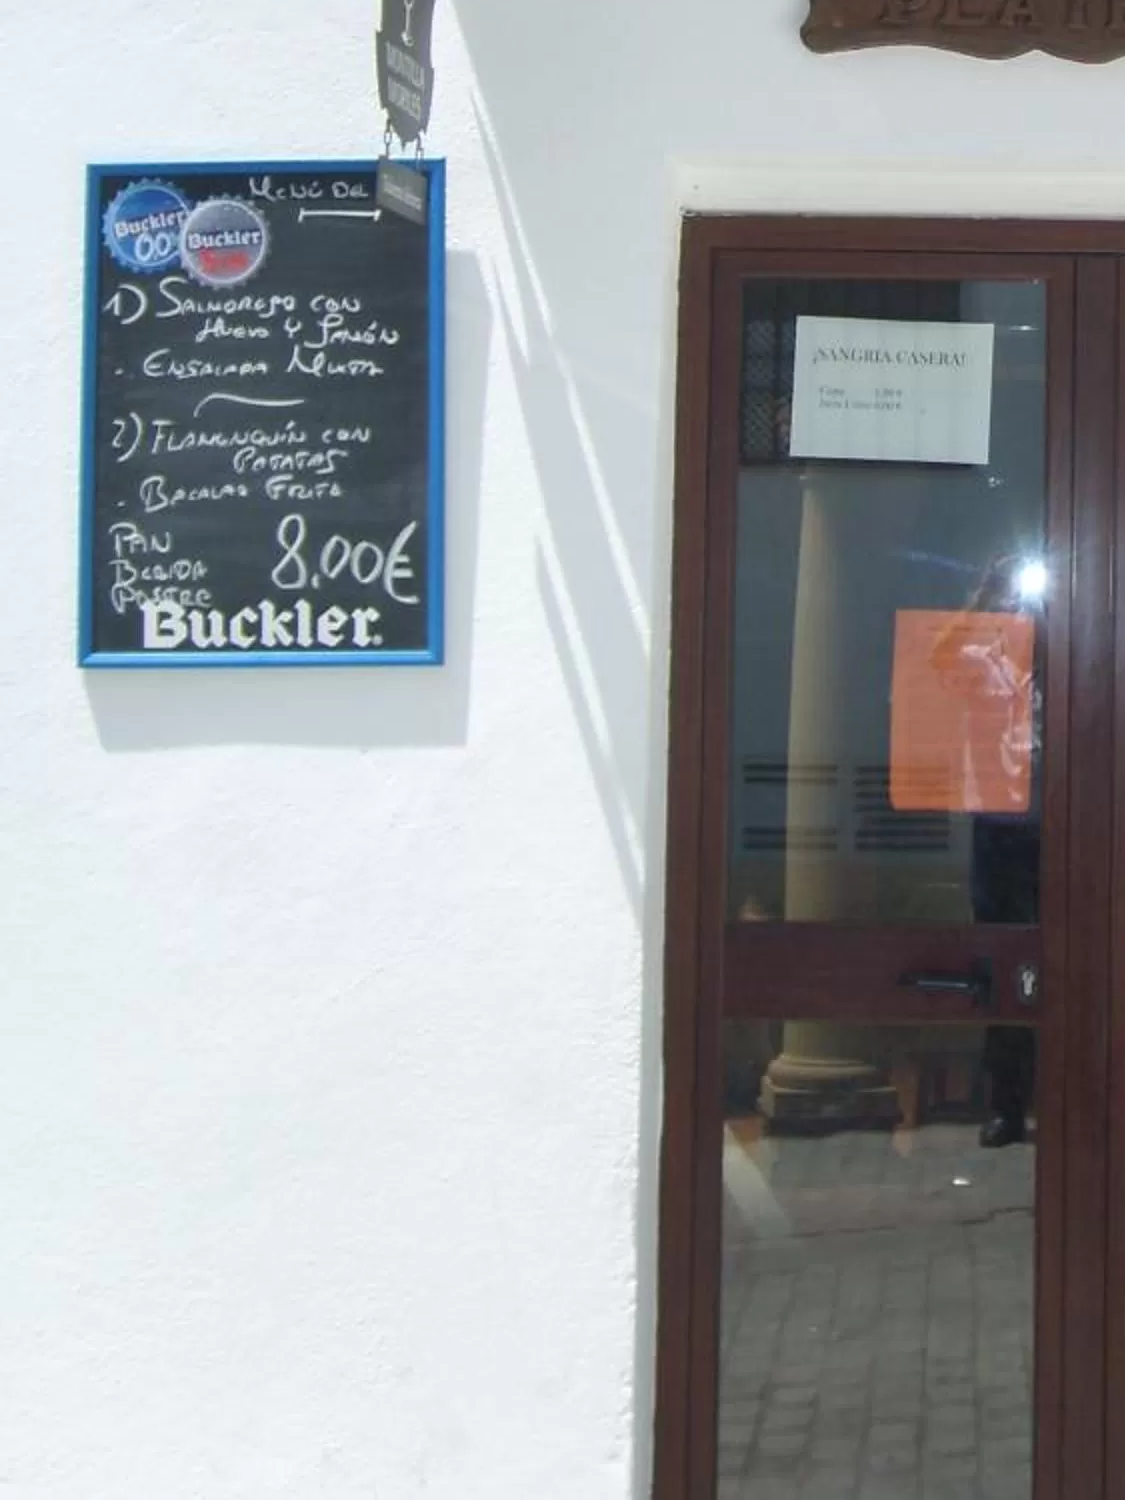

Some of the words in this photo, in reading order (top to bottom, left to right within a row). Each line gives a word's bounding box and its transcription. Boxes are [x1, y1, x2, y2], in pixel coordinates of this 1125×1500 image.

[114, 211, 187, 238] Buckler
[188, 231, 261, 250] Buckler
[141, 599, 381, 649] Buckler
